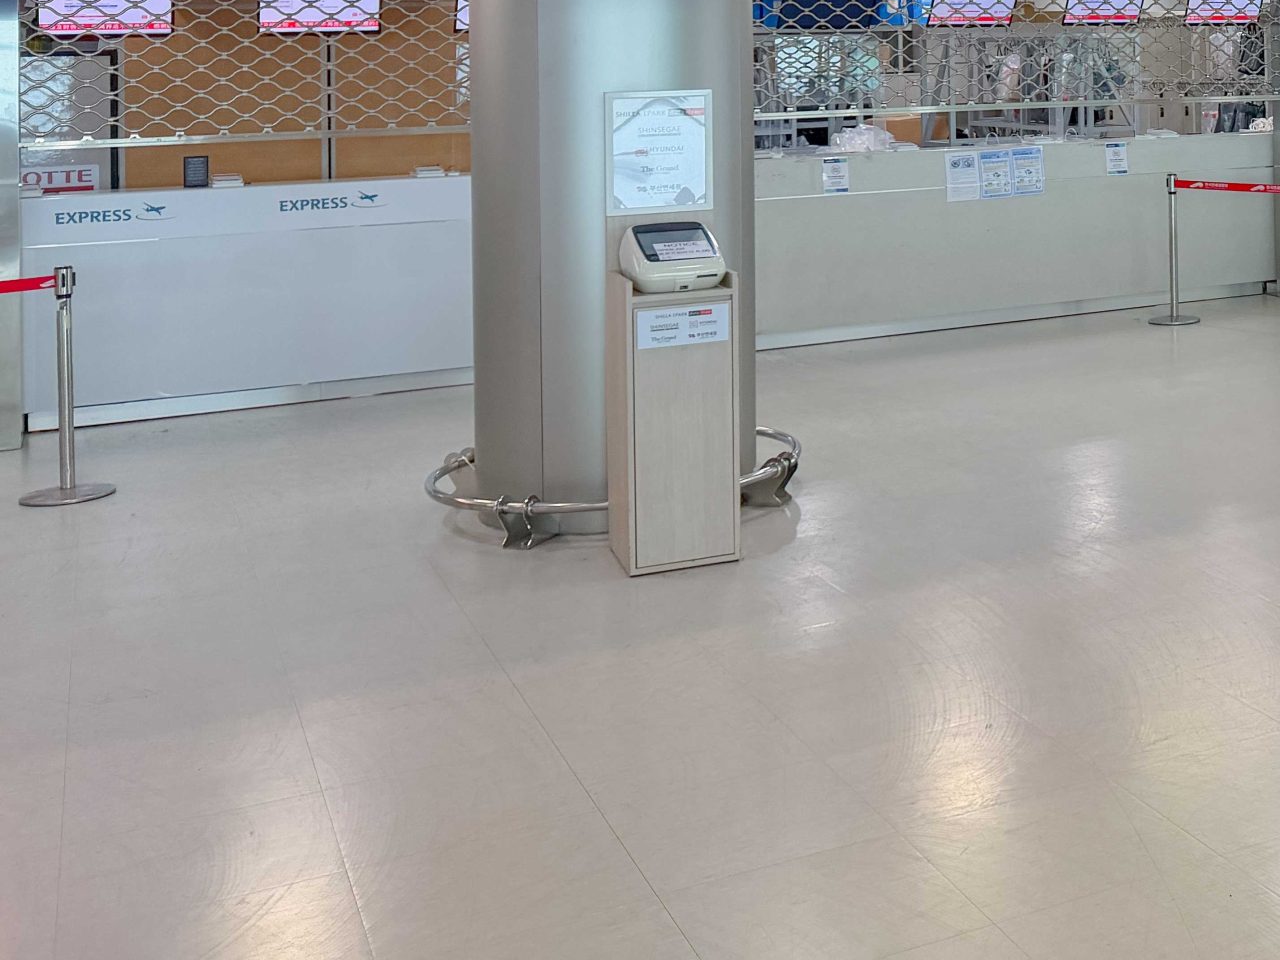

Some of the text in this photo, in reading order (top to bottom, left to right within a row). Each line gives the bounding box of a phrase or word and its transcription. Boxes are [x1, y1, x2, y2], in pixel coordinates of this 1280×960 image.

[649, 144, 684, 152] HYUNDAI
[22, 169, 93, 185] OTTE
[279, 196, 348, 212] EXPRESS
[54, 209, 132, 225] EXPRESS
